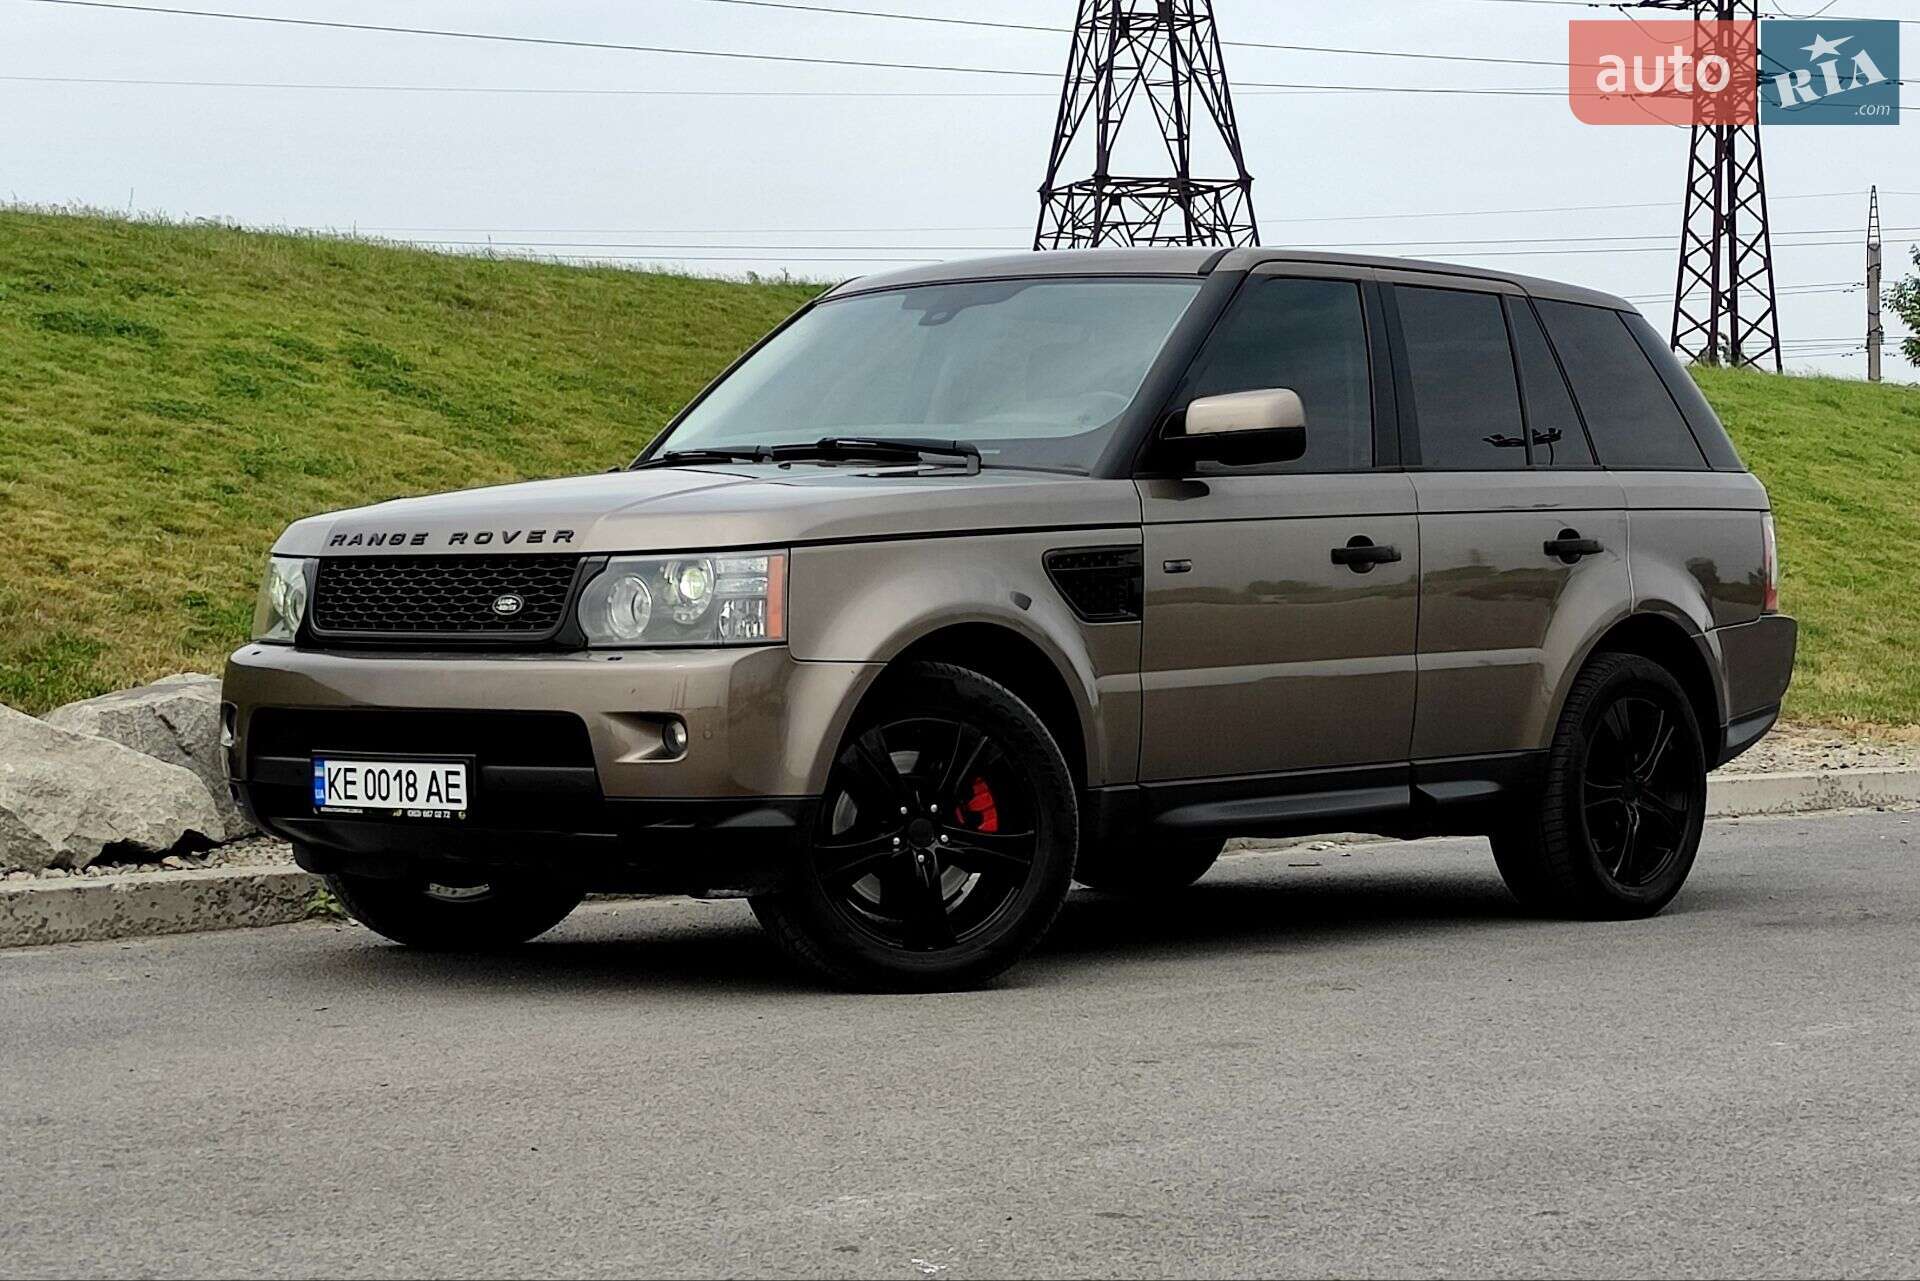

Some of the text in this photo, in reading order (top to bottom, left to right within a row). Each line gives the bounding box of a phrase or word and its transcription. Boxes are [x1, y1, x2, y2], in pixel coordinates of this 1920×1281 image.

[329, 529, 576, 547] RANGE ROVER
[327, 767, 463, 804] KE 0018 AE
